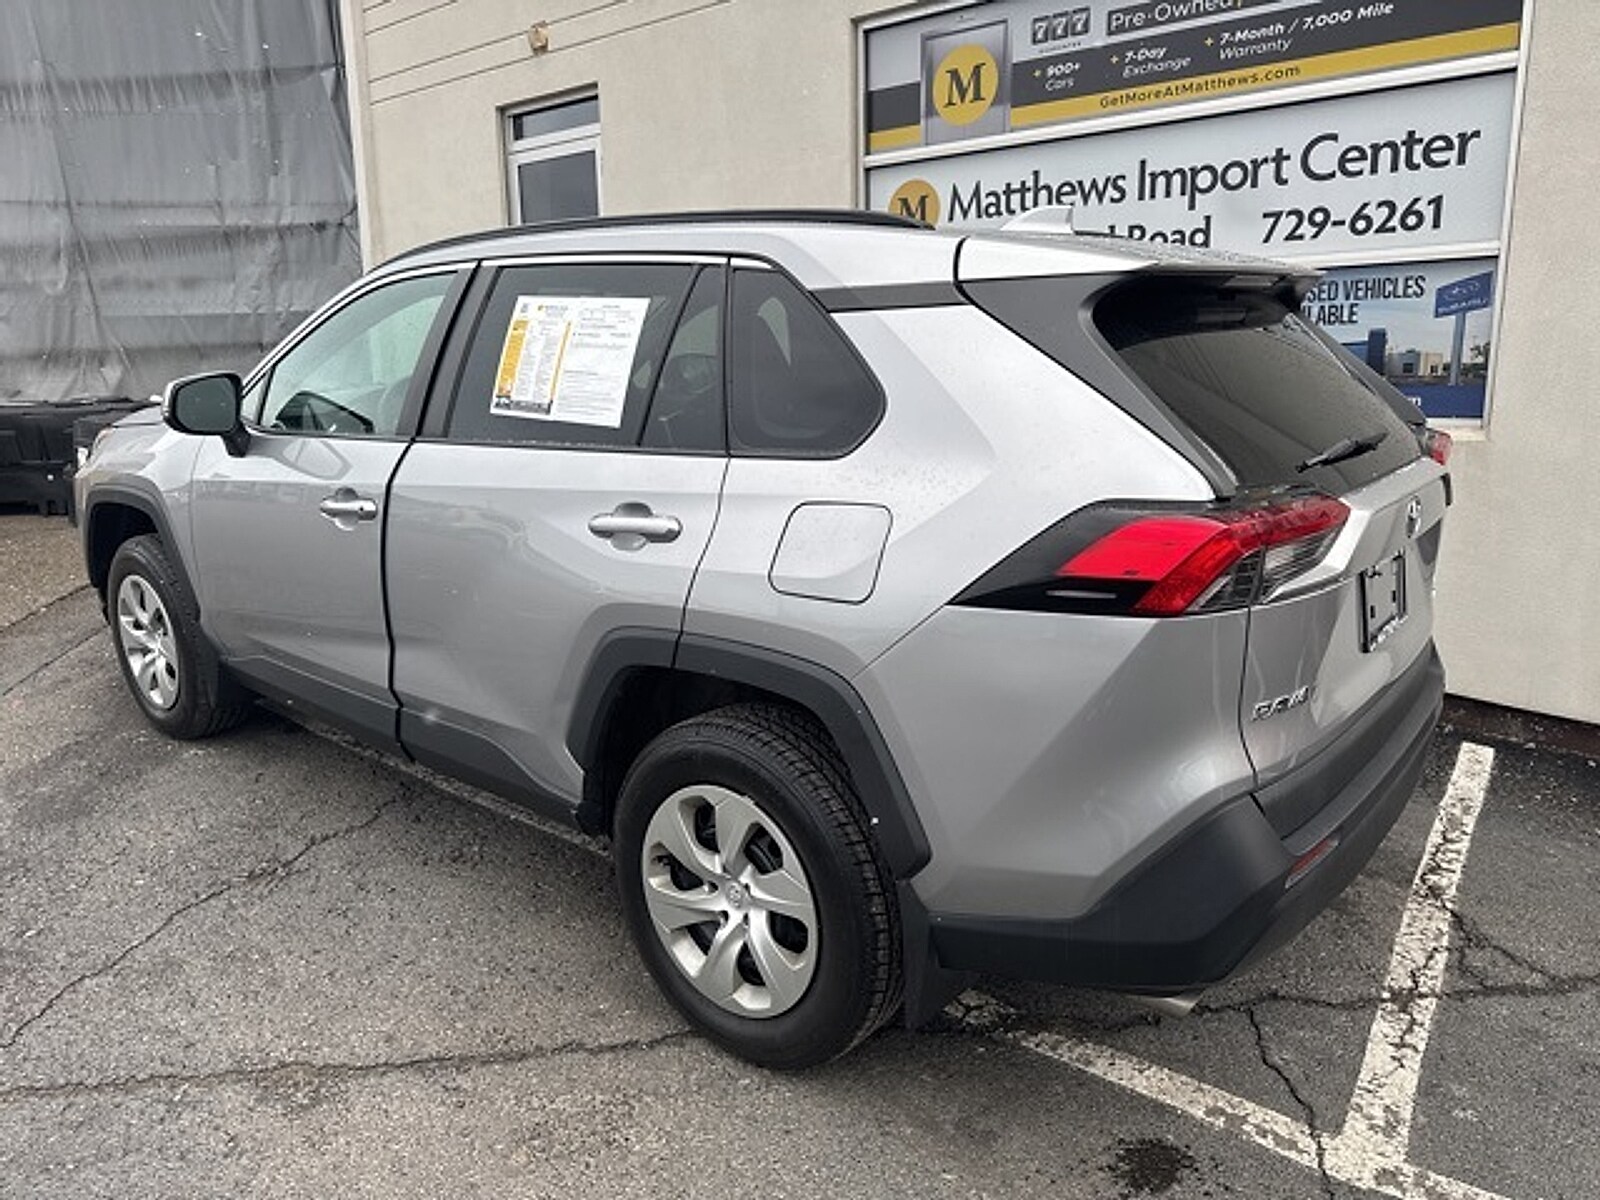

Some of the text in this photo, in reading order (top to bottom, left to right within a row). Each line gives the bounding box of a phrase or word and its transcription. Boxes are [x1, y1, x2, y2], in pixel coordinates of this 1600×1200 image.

[1220, 22, 1285, 45] 7-Month
[1302, 10, 1353, 30] 7,000
[1357, 3, 1395, 20] Mile
[1124, 45, 1167, 63] 7-Day
[1219, 38, 1293, 60] Warranty
[1046, 61, 1082, 78] 900+
[1122, 56, 1192, 79] Exchange
[943, 62, 987, 109] M
[1044, 77, 1075, 92] Cars
[1099, 66, 1301, 109] GetMoreAtMatthews.com
[947, 129, 1482, 222] Matthews Import Center
[1261, 194, 1445, 244] 729-6261
[1342, 275, 1427, 301] VEHICLES
